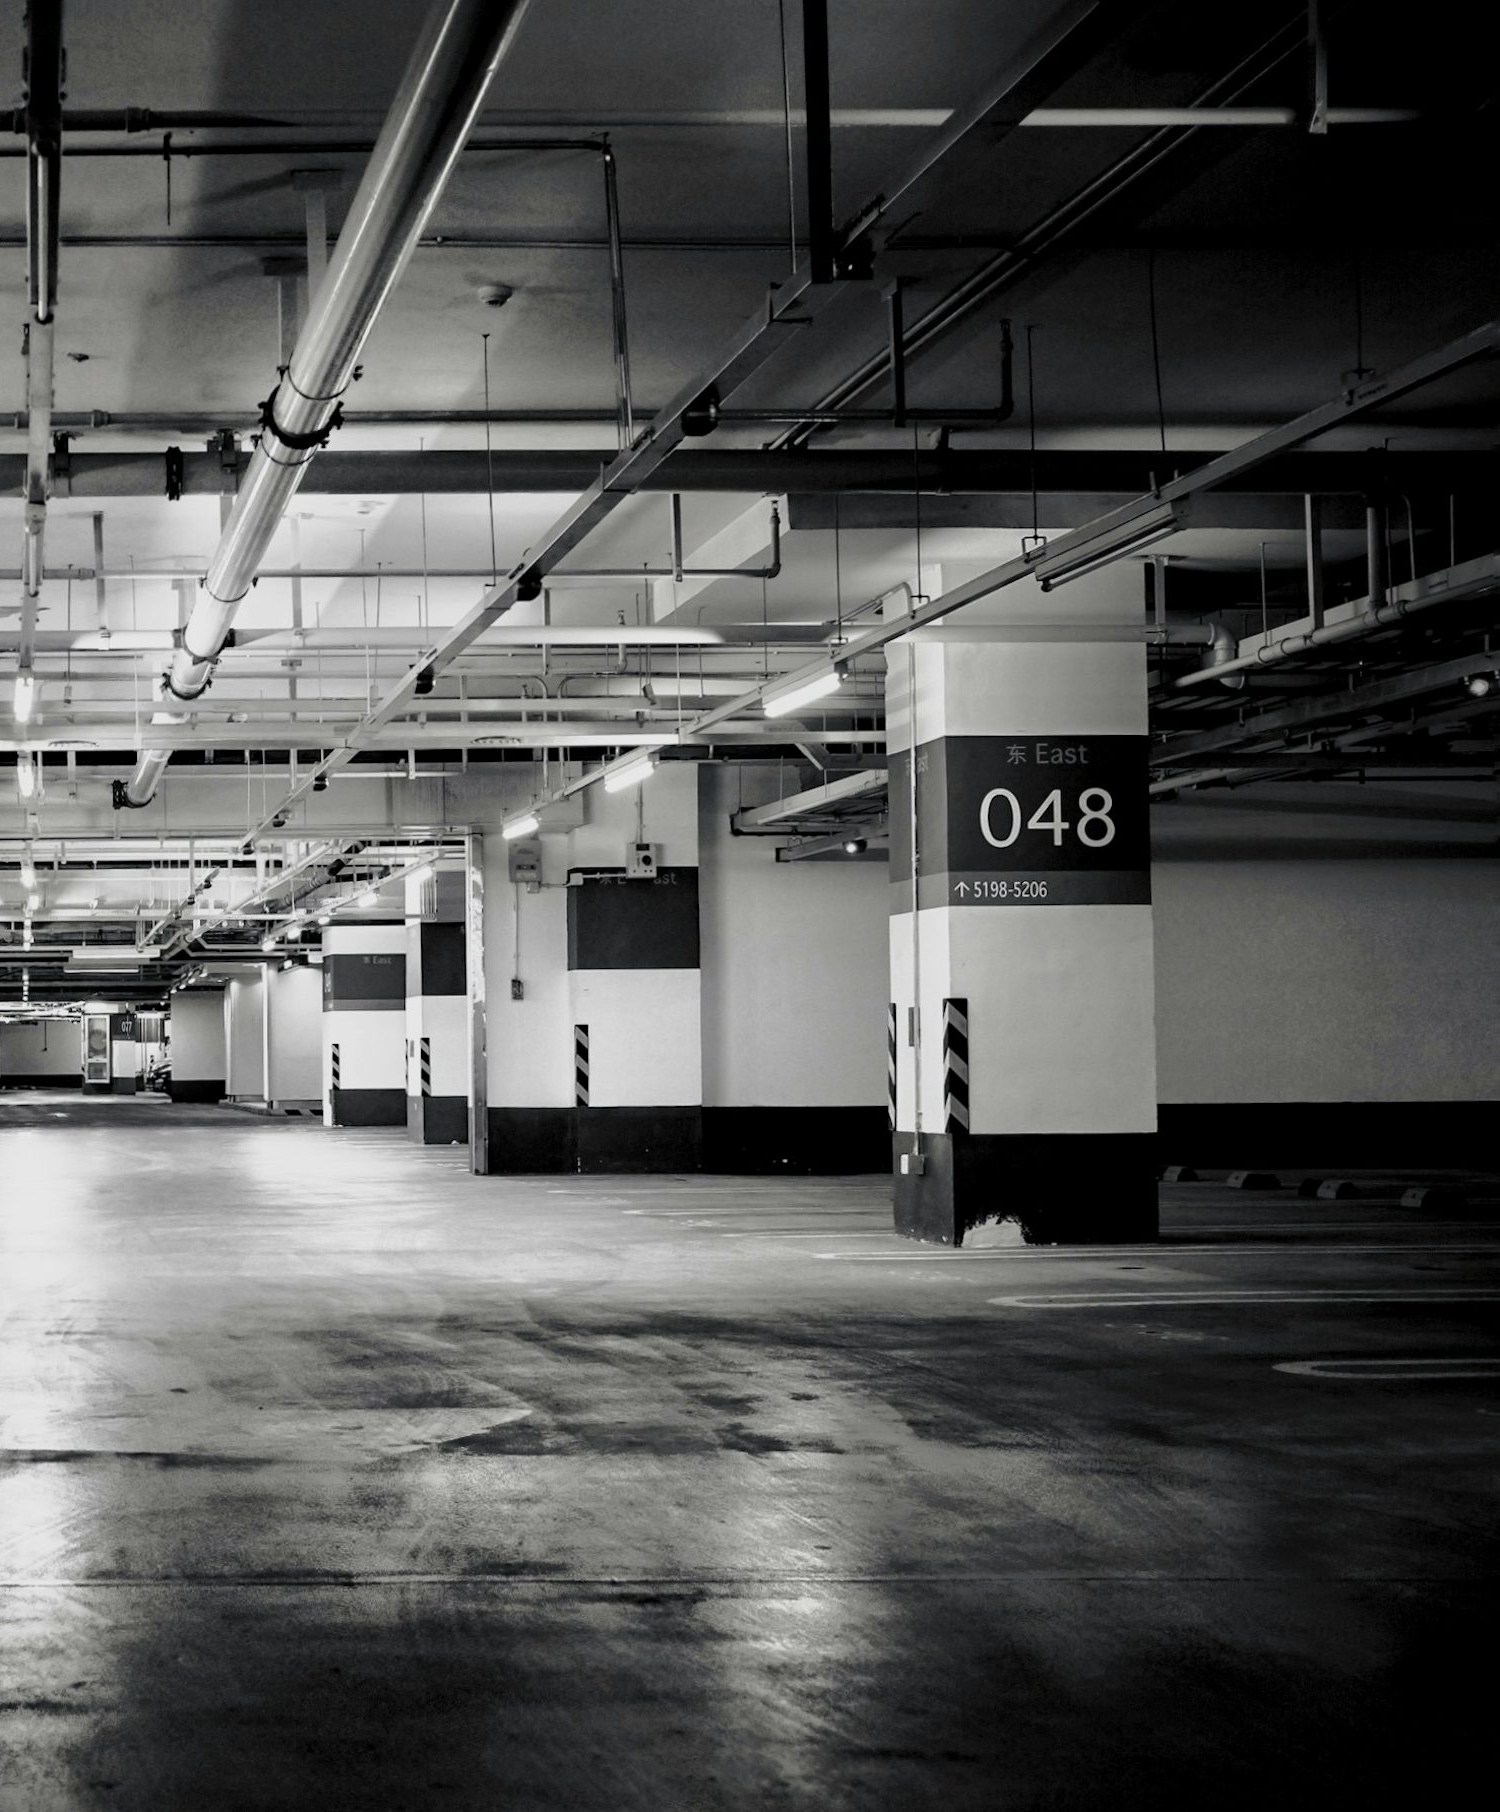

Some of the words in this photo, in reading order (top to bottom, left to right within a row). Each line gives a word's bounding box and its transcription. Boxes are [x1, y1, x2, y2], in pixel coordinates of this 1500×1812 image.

[1005, 743, 1027, 765] 东
[1036, 743, 1089, 765] East
[979, 787, 1116, 849] 048
[973, 881, 1048, 898] 5198-5206
